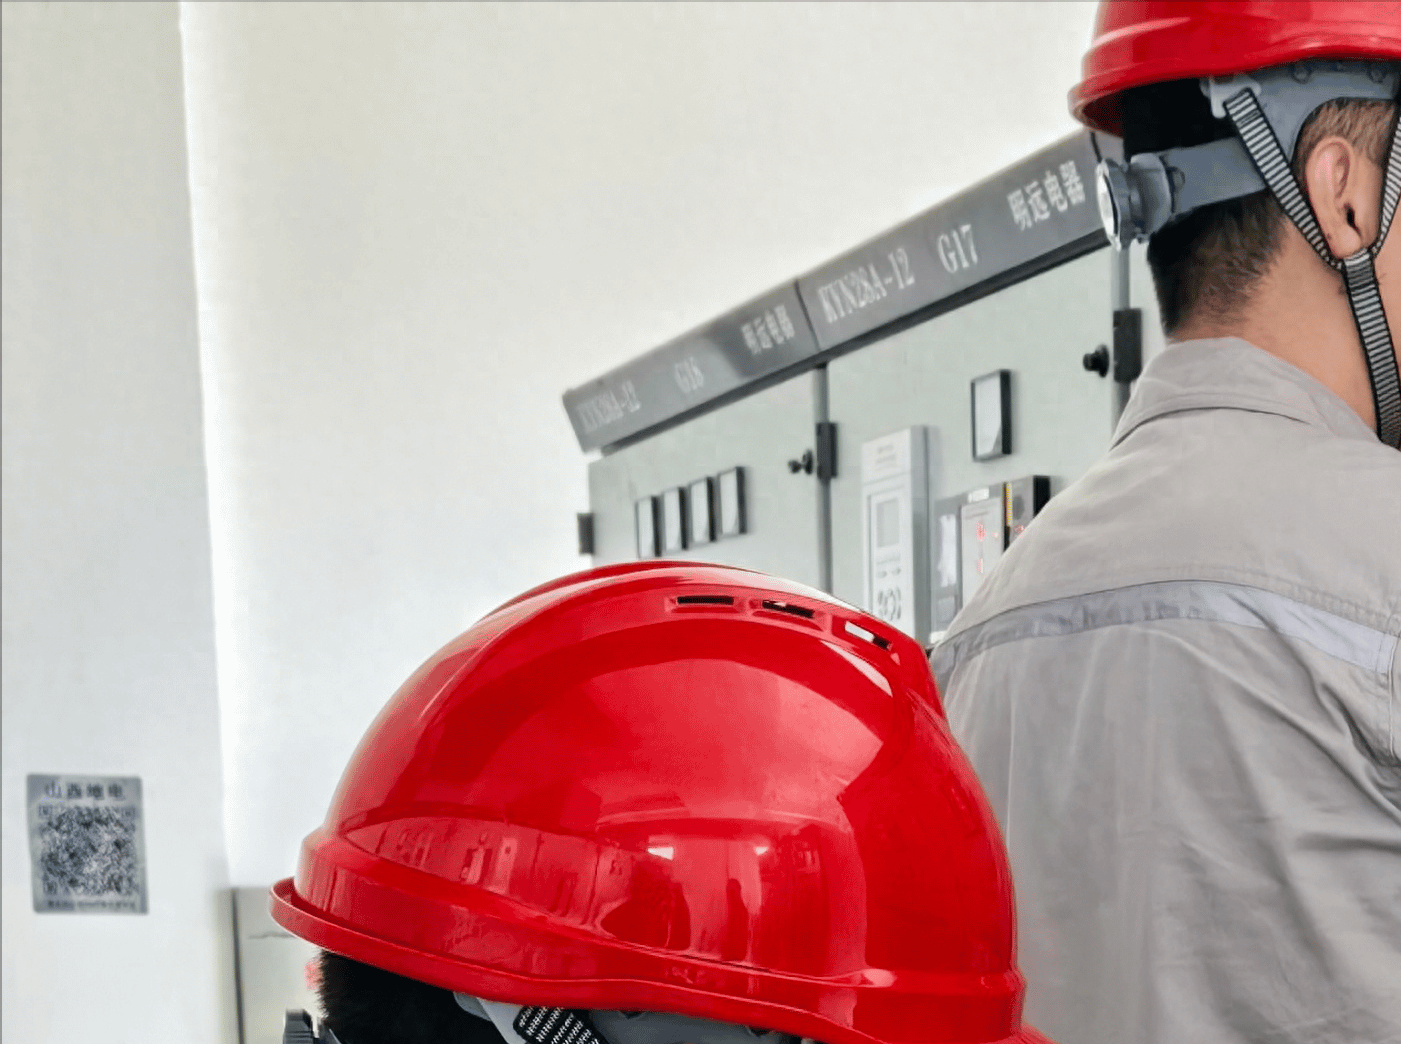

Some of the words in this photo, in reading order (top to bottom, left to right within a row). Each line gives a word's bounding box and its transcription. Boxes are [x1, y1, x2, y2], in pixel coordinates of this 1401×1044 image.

[936, 223, 979, 275] G17
[1006, 159, 1087, 232] 明远电器
